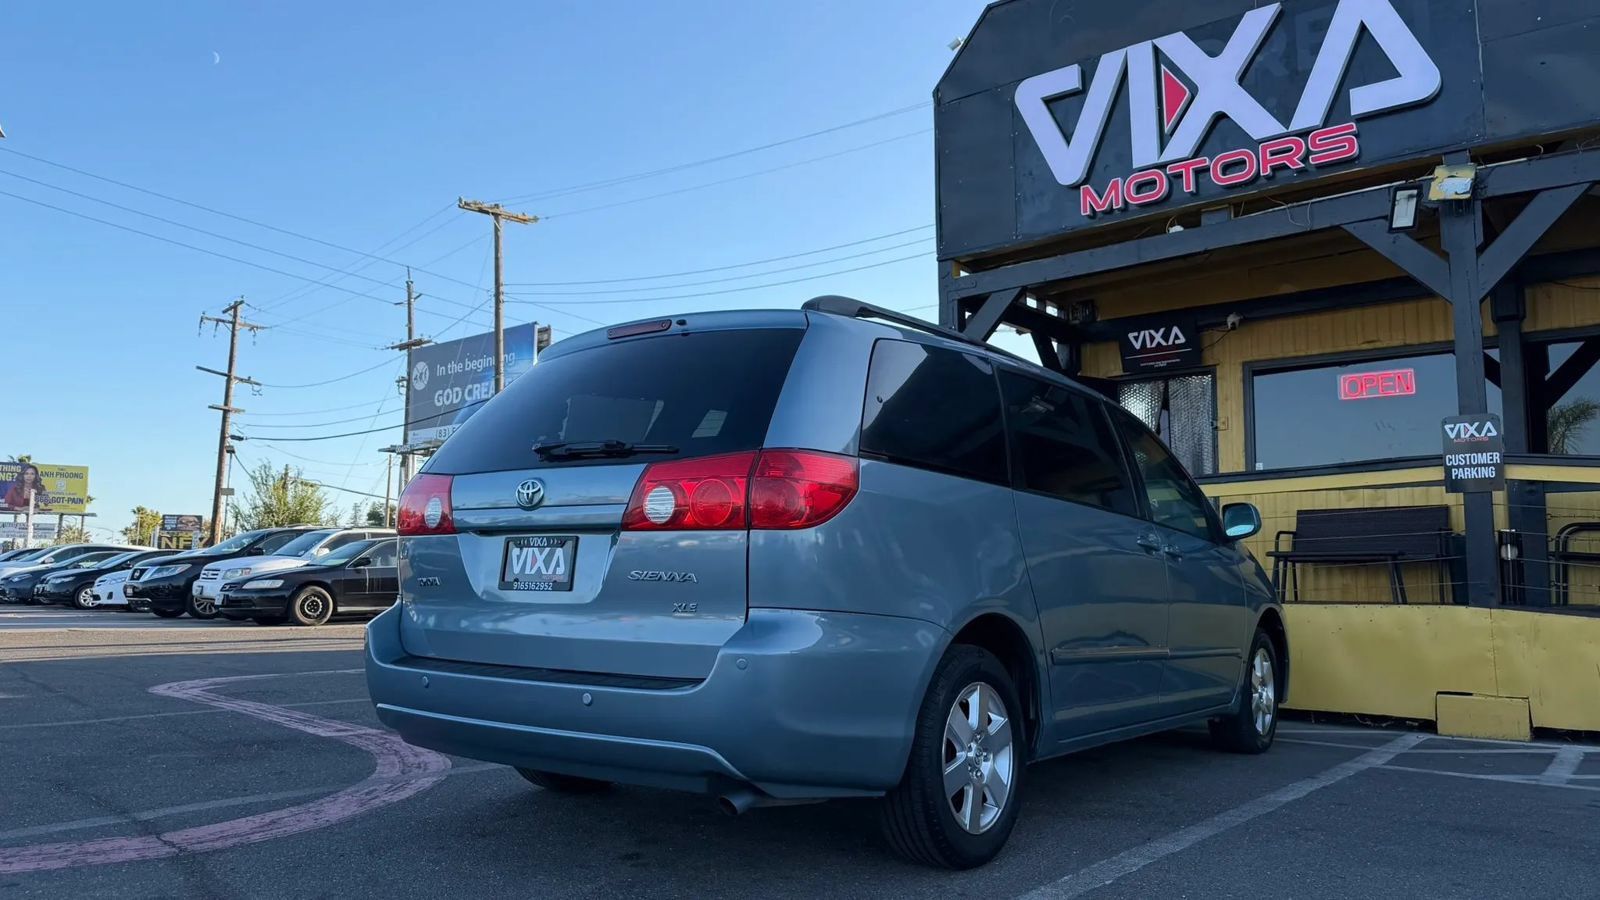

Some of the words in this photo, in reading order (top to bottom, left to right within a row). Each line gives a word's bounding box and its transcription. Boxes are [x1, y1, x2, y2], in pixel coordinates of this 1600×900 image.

[1014, 0, 1441, 186] VIXA
[1080, 122, 1360, 217] MOTORS
[1128, 325, 1186, 350] VIXA
[437, 364, 445, 376] In
[448, 361, 463, 374] the
[465, 352, 515, 372] beginng
[434, 387, 462, 406] GOD
[464, 379, 500, 401] CREA
[1345, 372, 1412, 397] OPEN
[1444, 421, 1498, 439] VIXA
[1445, 451, 1500, 466] CUSTOMER
[40, 470, 54, 478] ANH
[1452, 466, 1496, 480] PARKING
[529, 537, 547, 546] VIXA
[511, 547, 565, 575] VIXA
[627, 570, 698, 583] SIENNA
[512, 582, 553, 591] 9165162952
[672, 602, 697, 613] XLE
